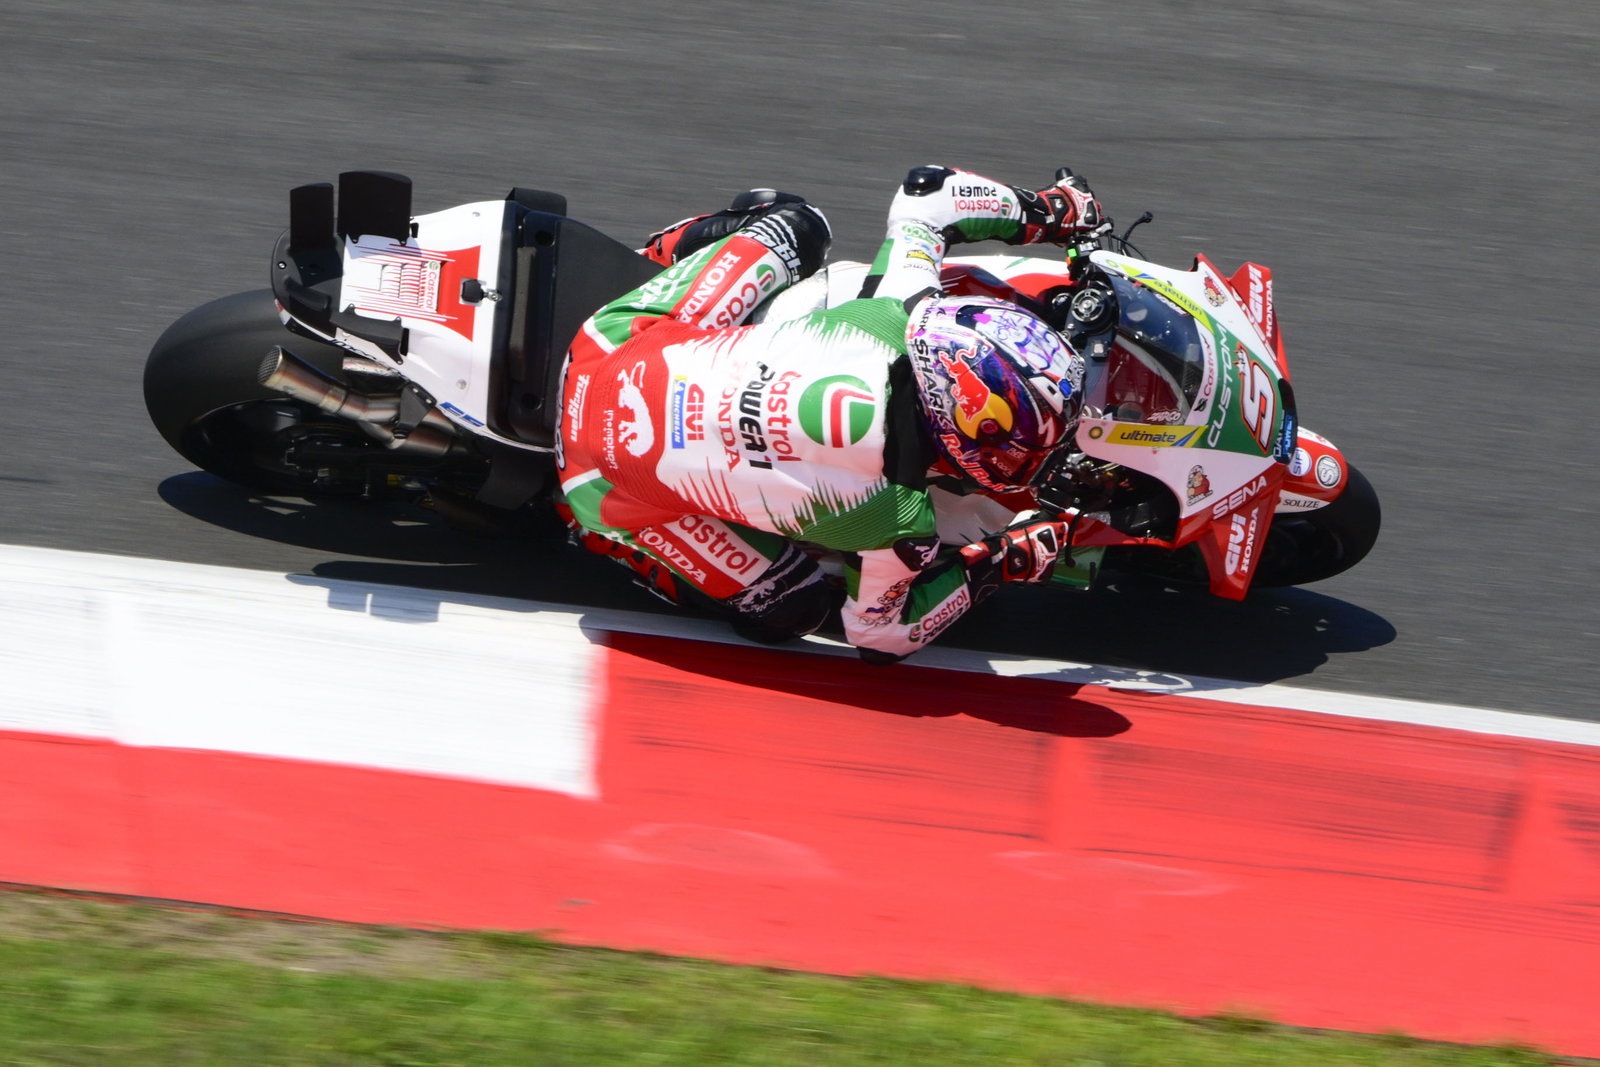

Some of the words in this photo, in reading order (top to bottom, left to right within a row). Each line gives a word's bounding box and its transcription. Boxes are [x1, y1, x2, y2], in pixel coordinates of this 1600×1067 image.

[955, 200, 1000, 213] Castrol
[426, 271, 437, 309] Castrol
[674, 251, 741, 324] HONDA
[1153, 280, 1203, 316] ultimate
[1249, 264, 1266, 323] GIVI
[685, 383, 704, 441] GIVI
[914, 338, 955, 430] SHARK
[1207, 321, 1234, 448] CUSTOM
[673, 394, 682, 443] MICHELIN
[718, 362, 747, 472] ONDA
[1120, 430, 1176, 443] ultimate
[940, 434, 981, 469] Red
[1213, 476, 1268, 520] SENA
[1282, 498, 1320, 509] SOLIZE
[639, 527, 707, 584] ONDA
[678, 514, 759, 575] astrol
[1225, 513, 1247, 575] GIVI
[1241, 508, 1259, 573] HONDA
[922, 590, 968, 632] Castrol
